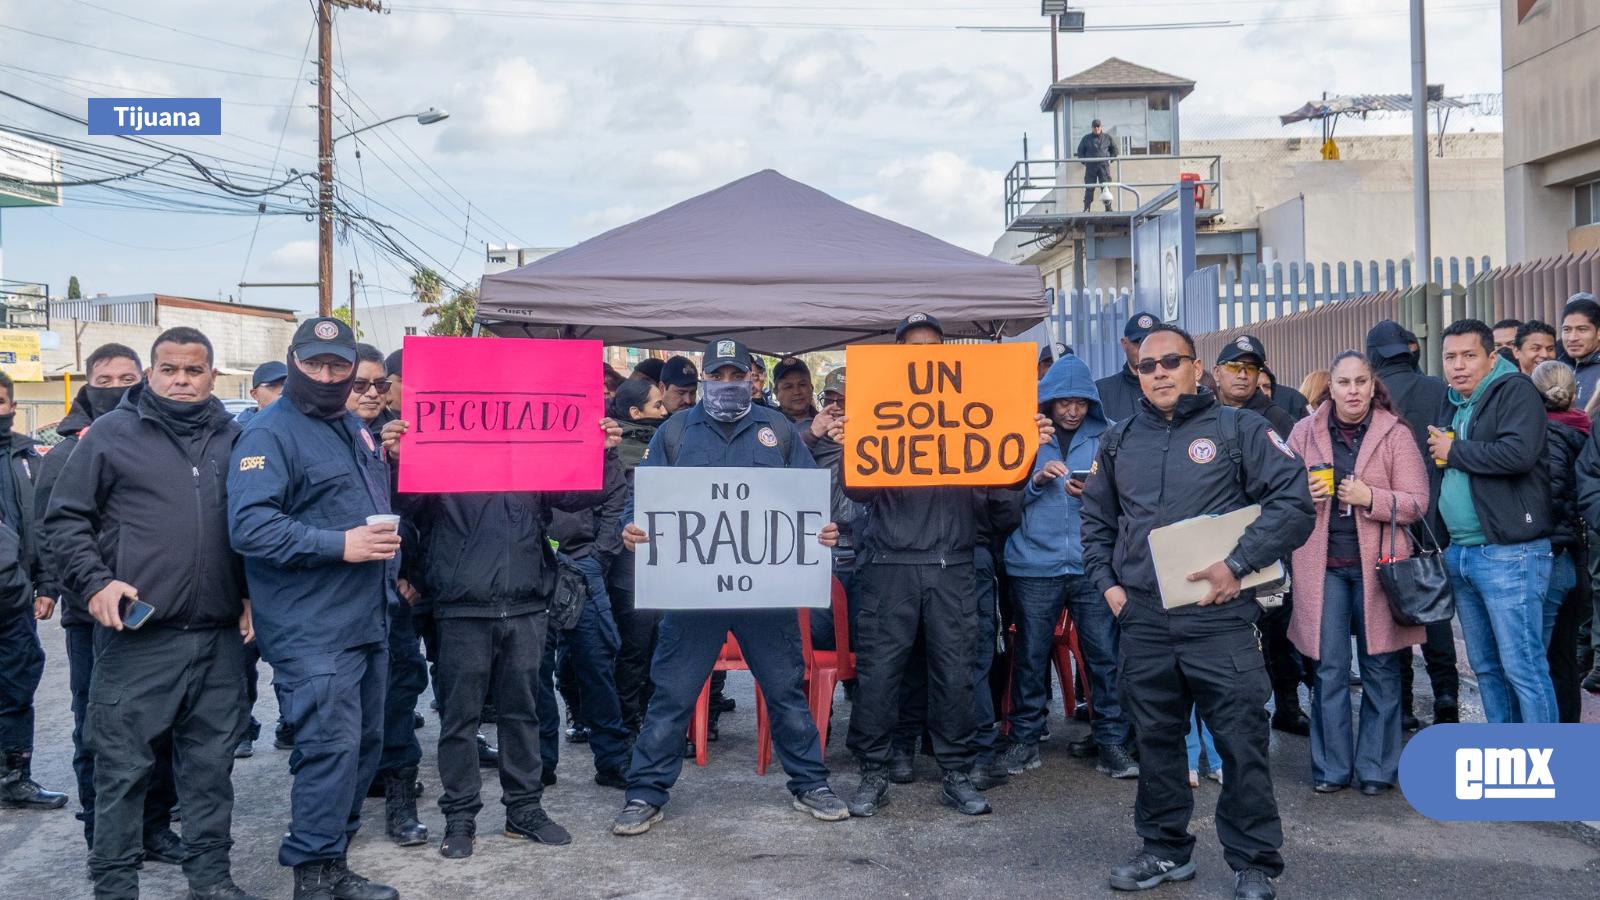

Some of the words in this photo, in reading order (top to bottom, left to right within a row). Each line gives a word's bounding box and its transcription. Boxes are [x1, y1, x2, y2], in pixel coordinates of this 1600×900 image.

[907, 360, 962, 396] UN
[416, 400, 580, 433] PECULADO
[873, 400, 994, 431] SOLO
[856, 432, 1025, 476] SUELDO
[711, 482, 750, 501] NO
[643, 509, 823, 566] FRAUDE
[717, 574, 753, 593] NO
